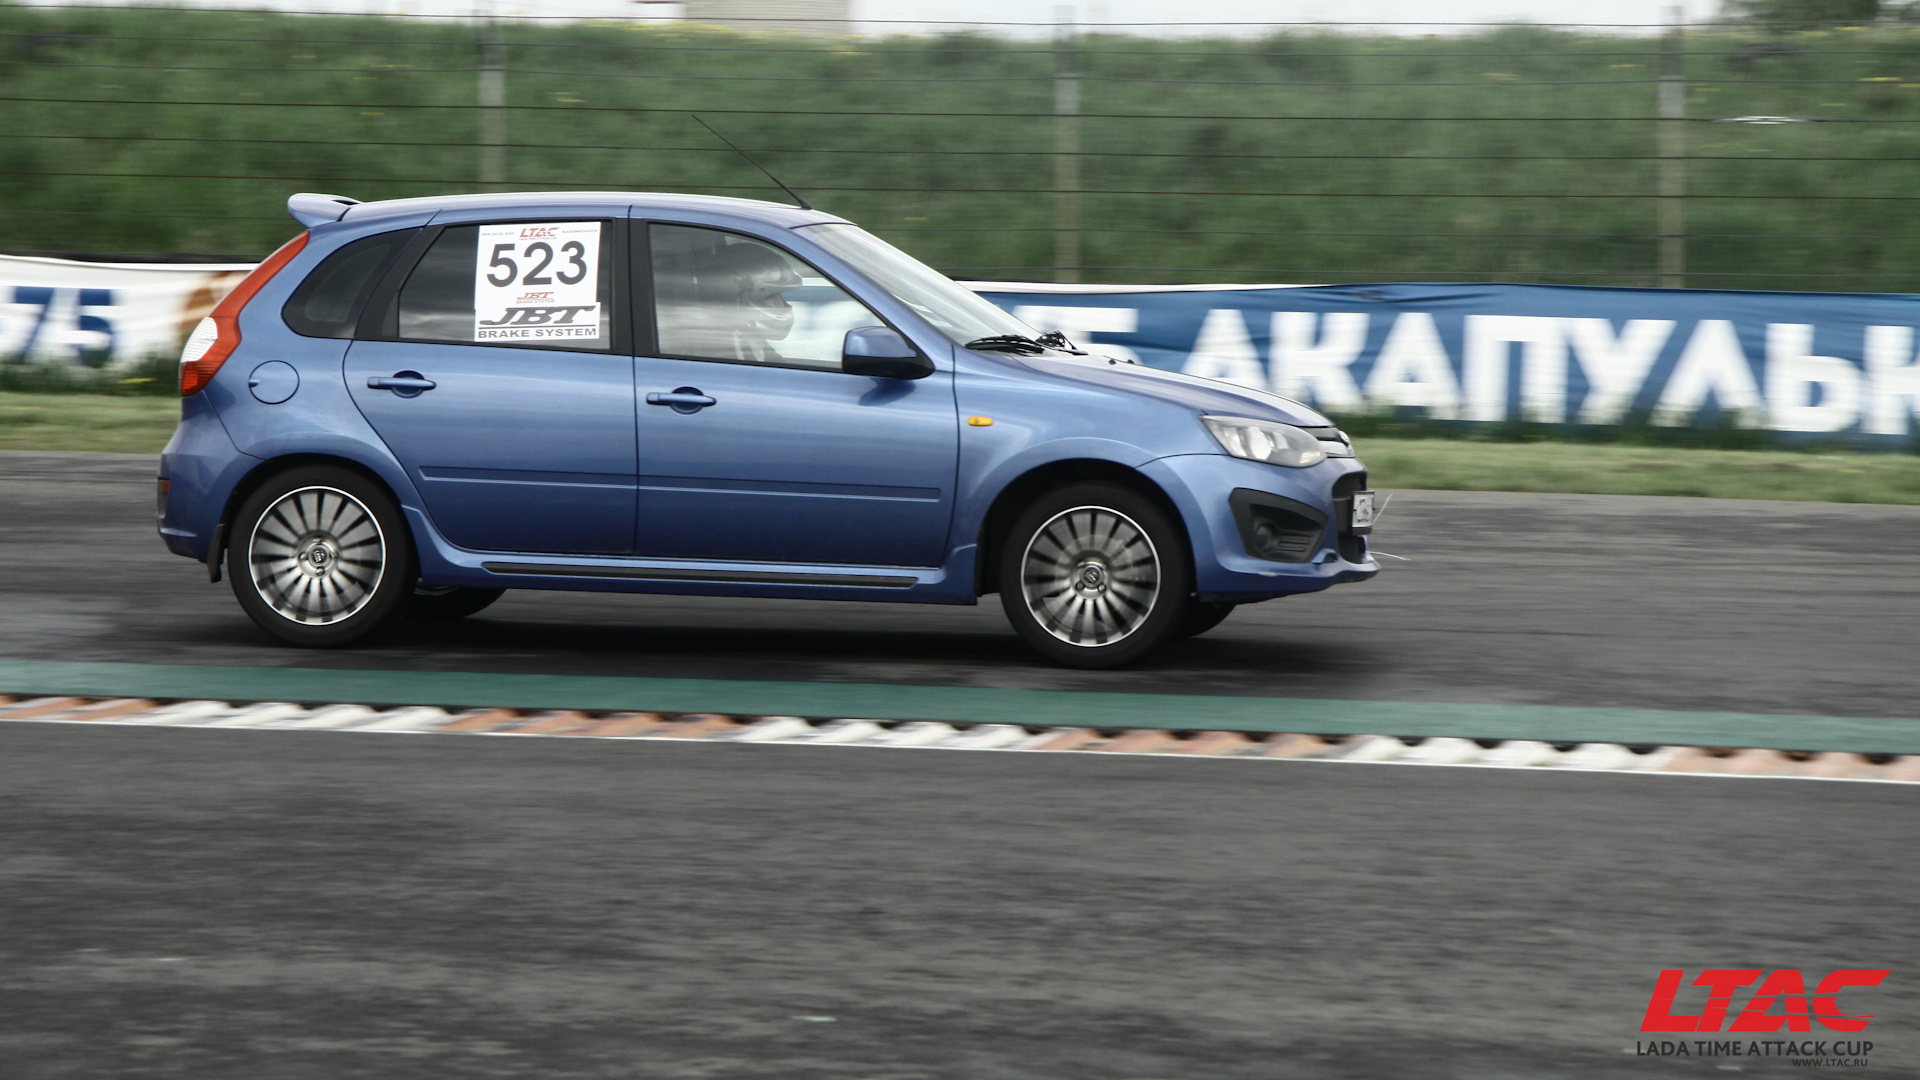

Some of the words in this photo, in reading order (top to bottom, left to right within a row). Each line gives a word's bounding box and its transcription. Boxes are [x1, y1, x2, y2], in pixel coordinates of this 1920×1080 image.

[519, 227, 559, 237] LTAC
[487, 240, 587, 288] 523
[479, 306, 596, 325] JBT
[478, 330, 530, 338] BRAKE
[535, 328, 596, 337] SYSTEM
